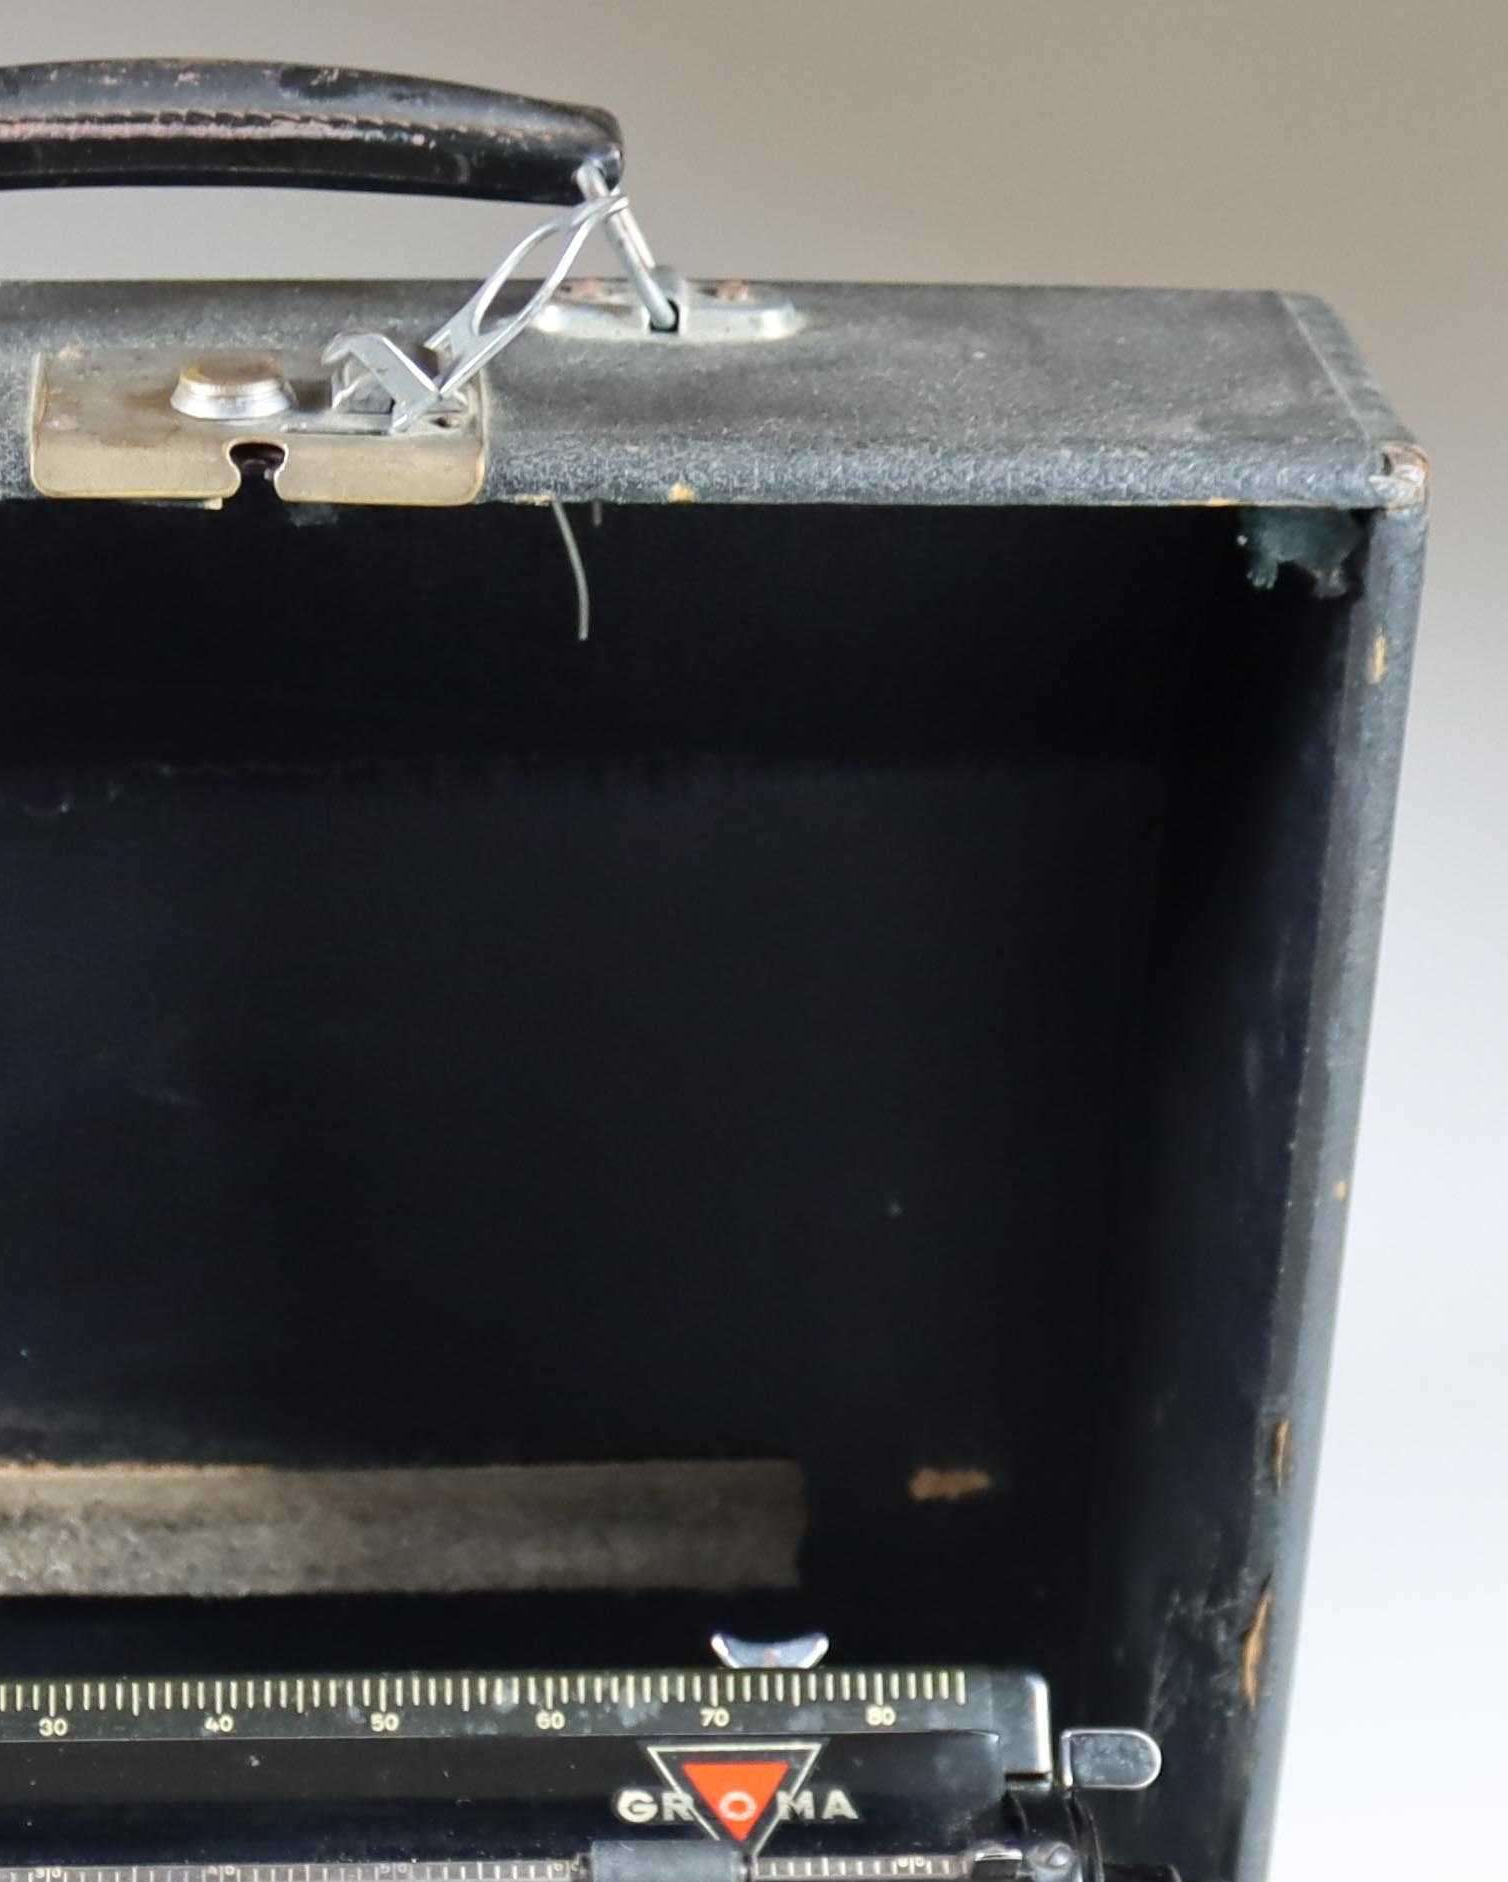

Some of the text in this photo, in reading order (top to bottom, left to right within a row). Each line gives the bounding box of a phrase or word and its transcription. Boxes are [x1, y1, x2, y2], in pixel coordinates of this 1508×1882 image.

[38, 1718, 69, 1737] 30
[203, 1713, 235, 1733] 40
[369, 1712, 401, 1732] 50
[535, 1710, 567, 1730] 60
[699, 1707, 731, 1728] 70
[864, 1705, 897, 1727] 80
[615, 1789, 860, 1824] GROMA
